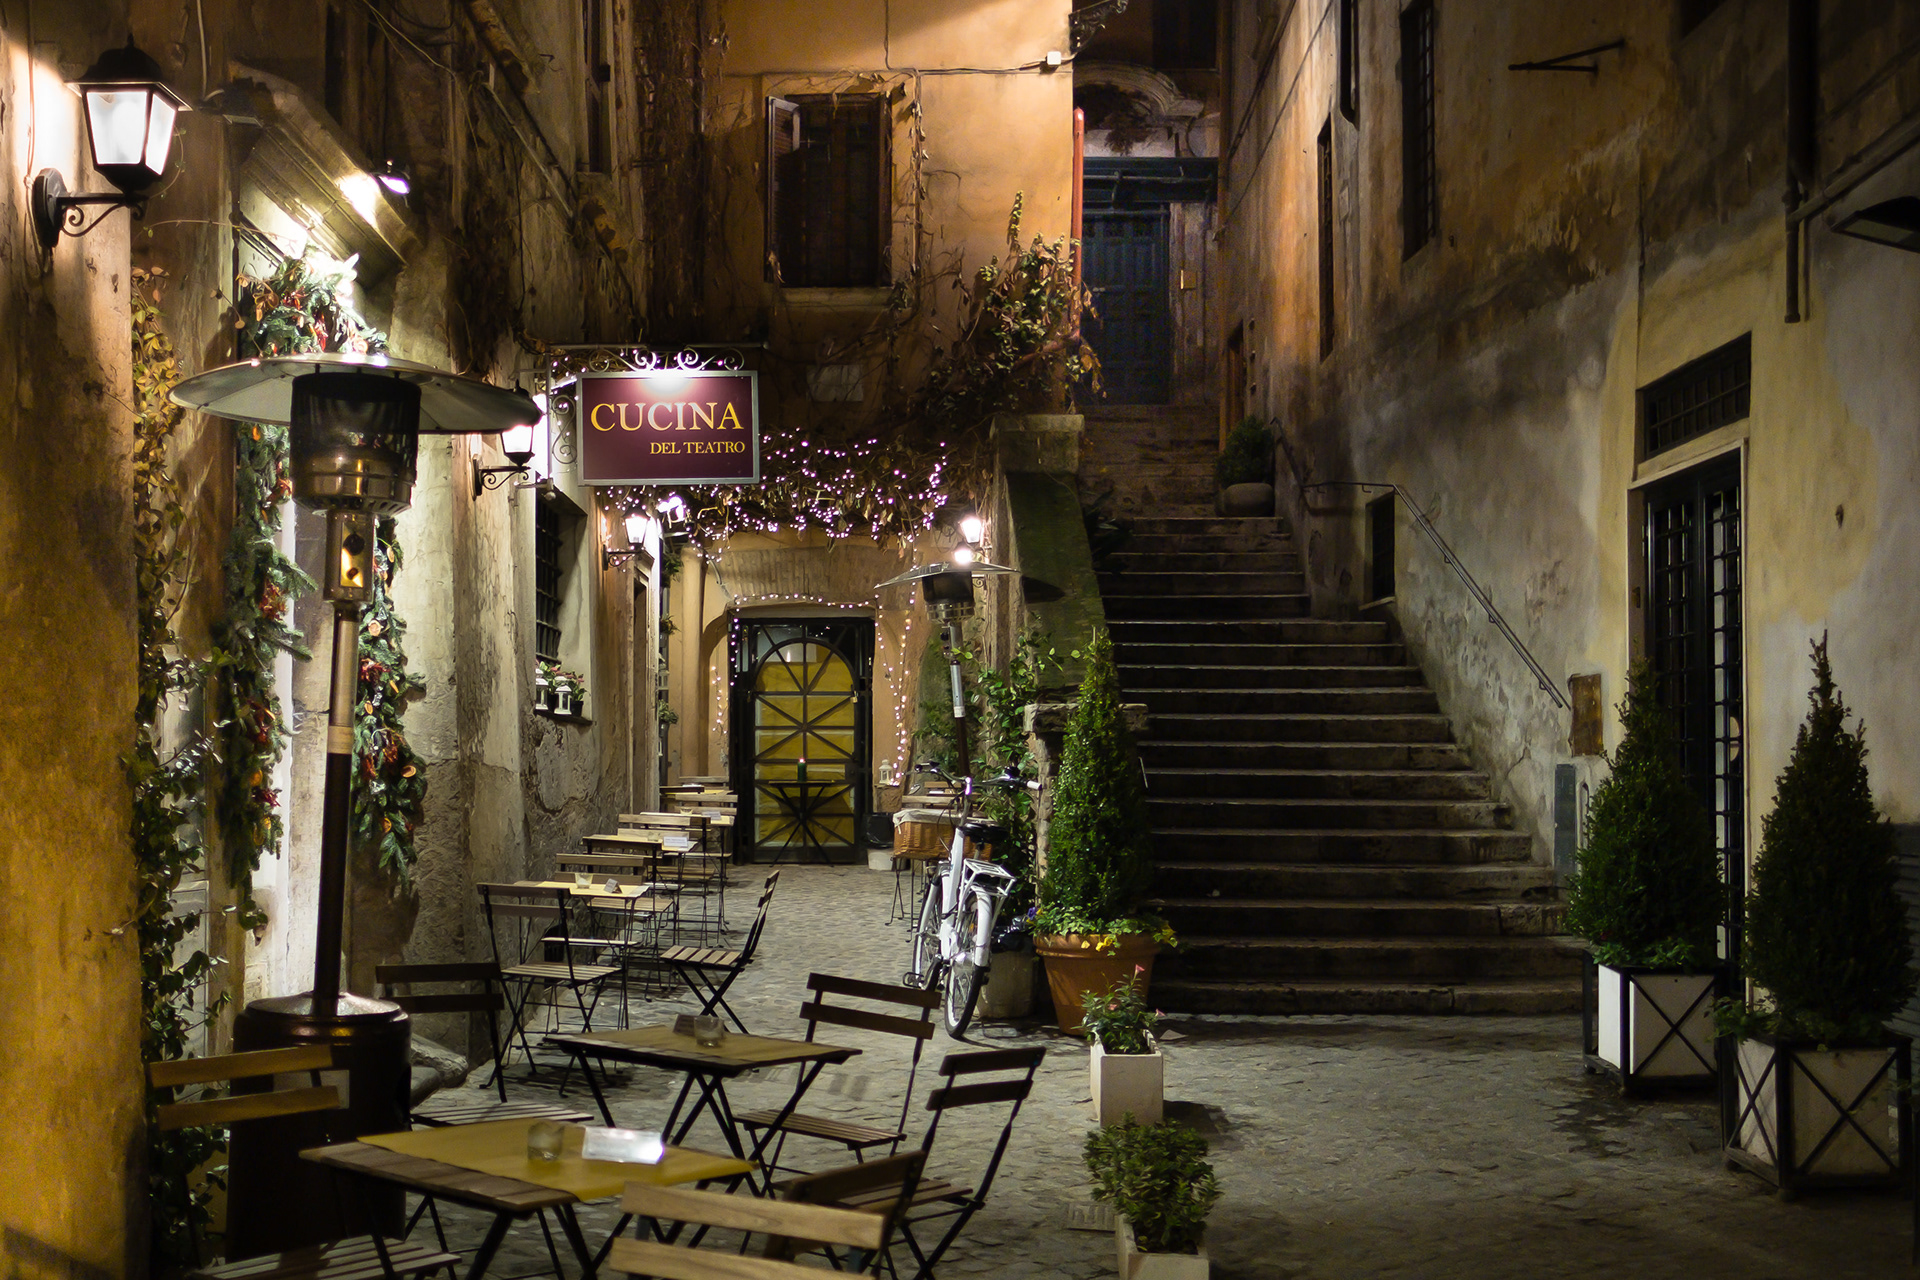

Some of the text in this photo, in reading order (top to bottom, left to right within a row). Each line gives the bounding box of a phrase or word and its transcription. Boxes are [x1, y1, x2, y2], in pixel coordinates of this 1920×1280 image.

[591, 402, 744, 431] CUCINA
[650, 441, 745, 454] DEL TEATRO
